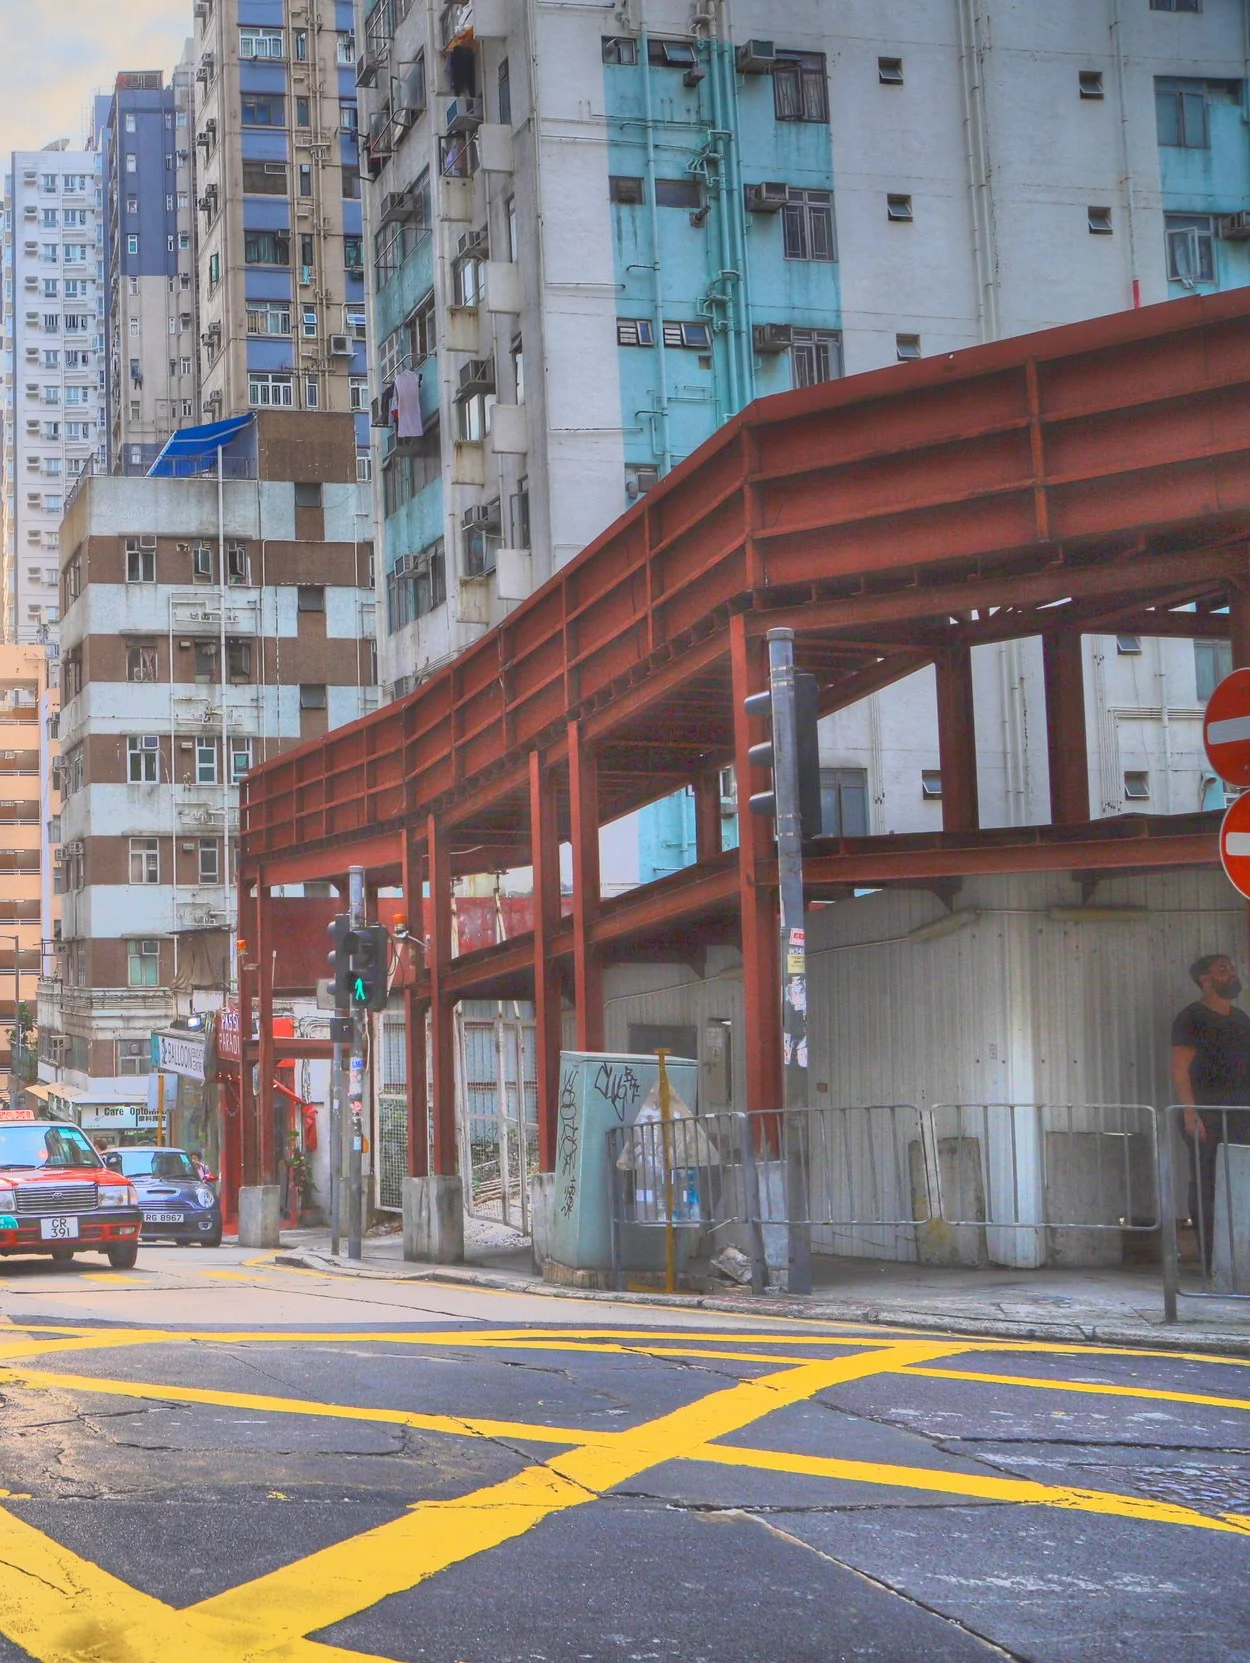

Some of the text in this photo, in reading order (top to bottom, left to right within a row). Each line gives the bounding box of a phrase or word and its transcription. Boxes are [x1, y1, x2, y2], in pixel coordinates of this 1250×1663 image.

[104, 1107, 124, 1116] Care
[51, 1218, 67, 1228] CR
[50, 1227, 70, 1237] 391
